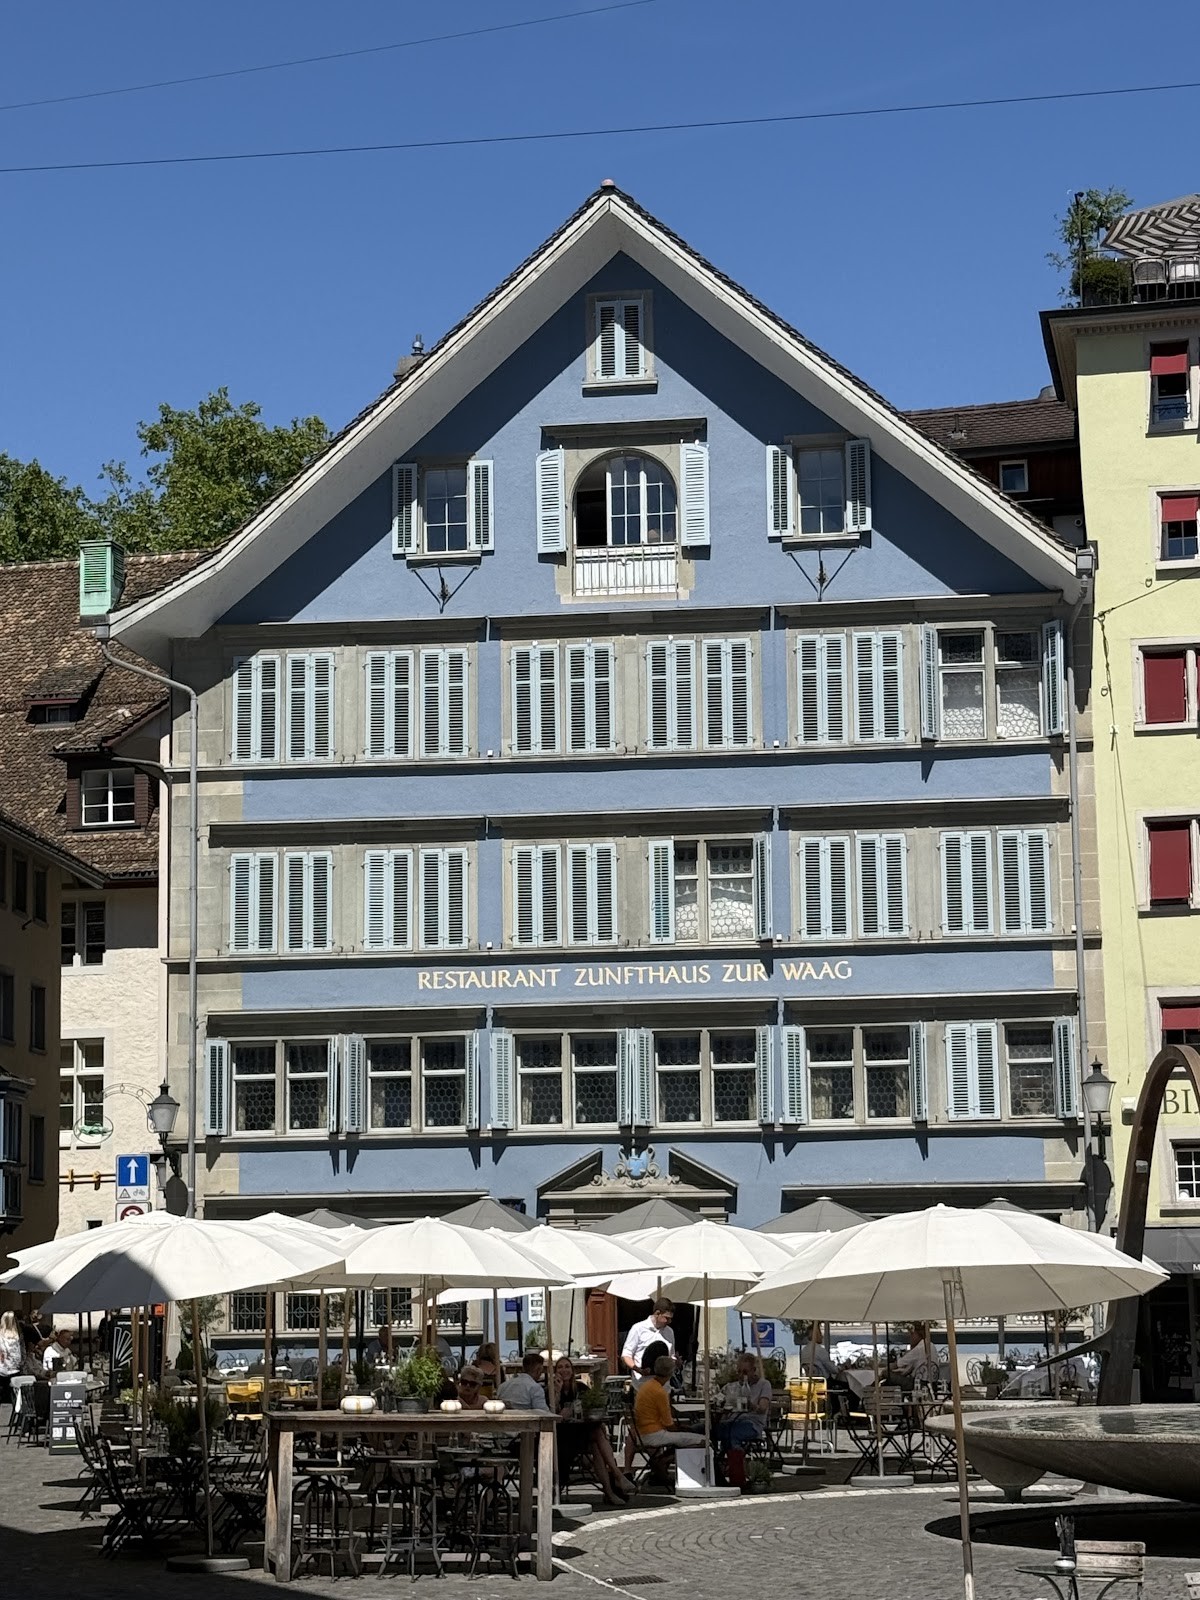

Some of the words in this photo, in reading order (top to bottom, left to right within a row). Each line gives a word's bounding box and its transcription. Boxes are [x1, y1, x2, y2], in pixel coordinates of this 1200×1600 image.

[418, 968, 561, 990] RESTAURANT
[574, 964, 711, 986] ZUNFTHAUS
[722, 963, 769, 983] ZUR
[780, 960, 852, 981] WAAG
[1161, 1088, 1200, 1115] BI
